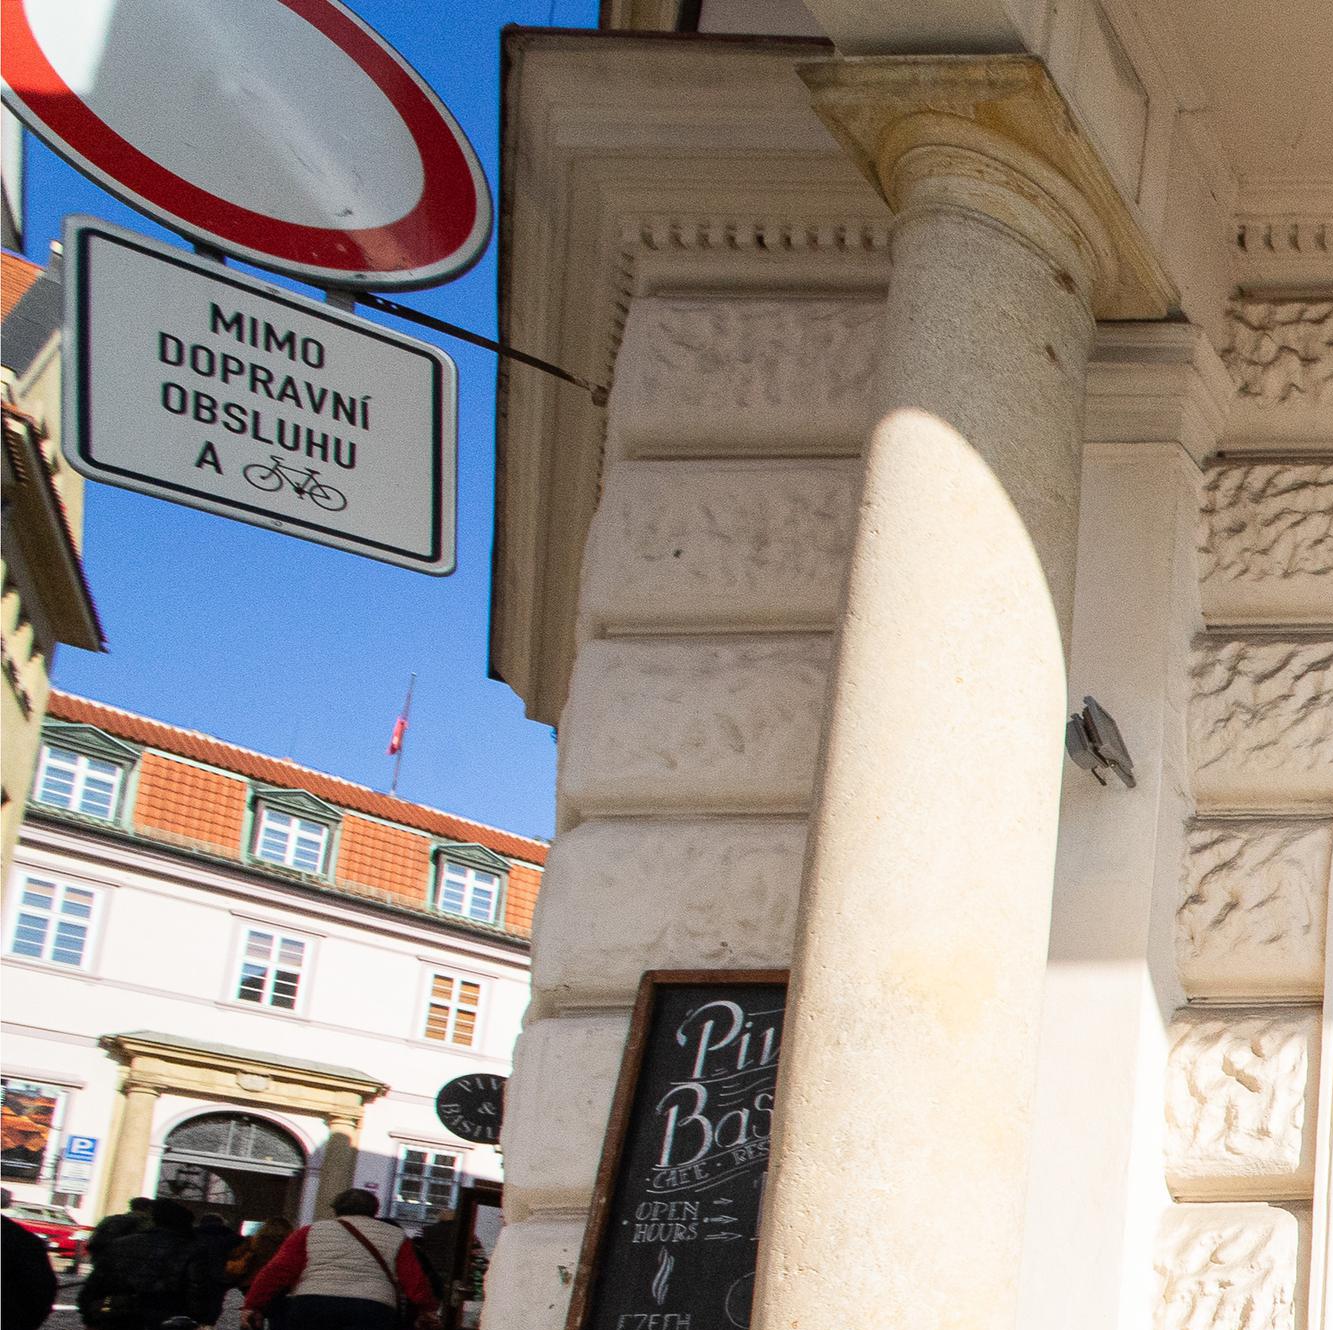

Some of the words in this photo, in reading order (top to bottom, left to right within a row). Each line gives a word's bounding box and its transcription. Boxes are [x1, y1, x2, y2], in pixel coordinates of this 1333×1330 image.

[210, 302, 325, 369] MIMO
[158, 331, 372, 431] DOPRAVNÍ
[162, 382, 356, 469] OBSLUHU
[195, 440, 224, 475] A
[70, 1138, 93, 1154] P
[635, 1201, 700, 1221] OPEN
[632, 1222, 699, 1243] HOURS
